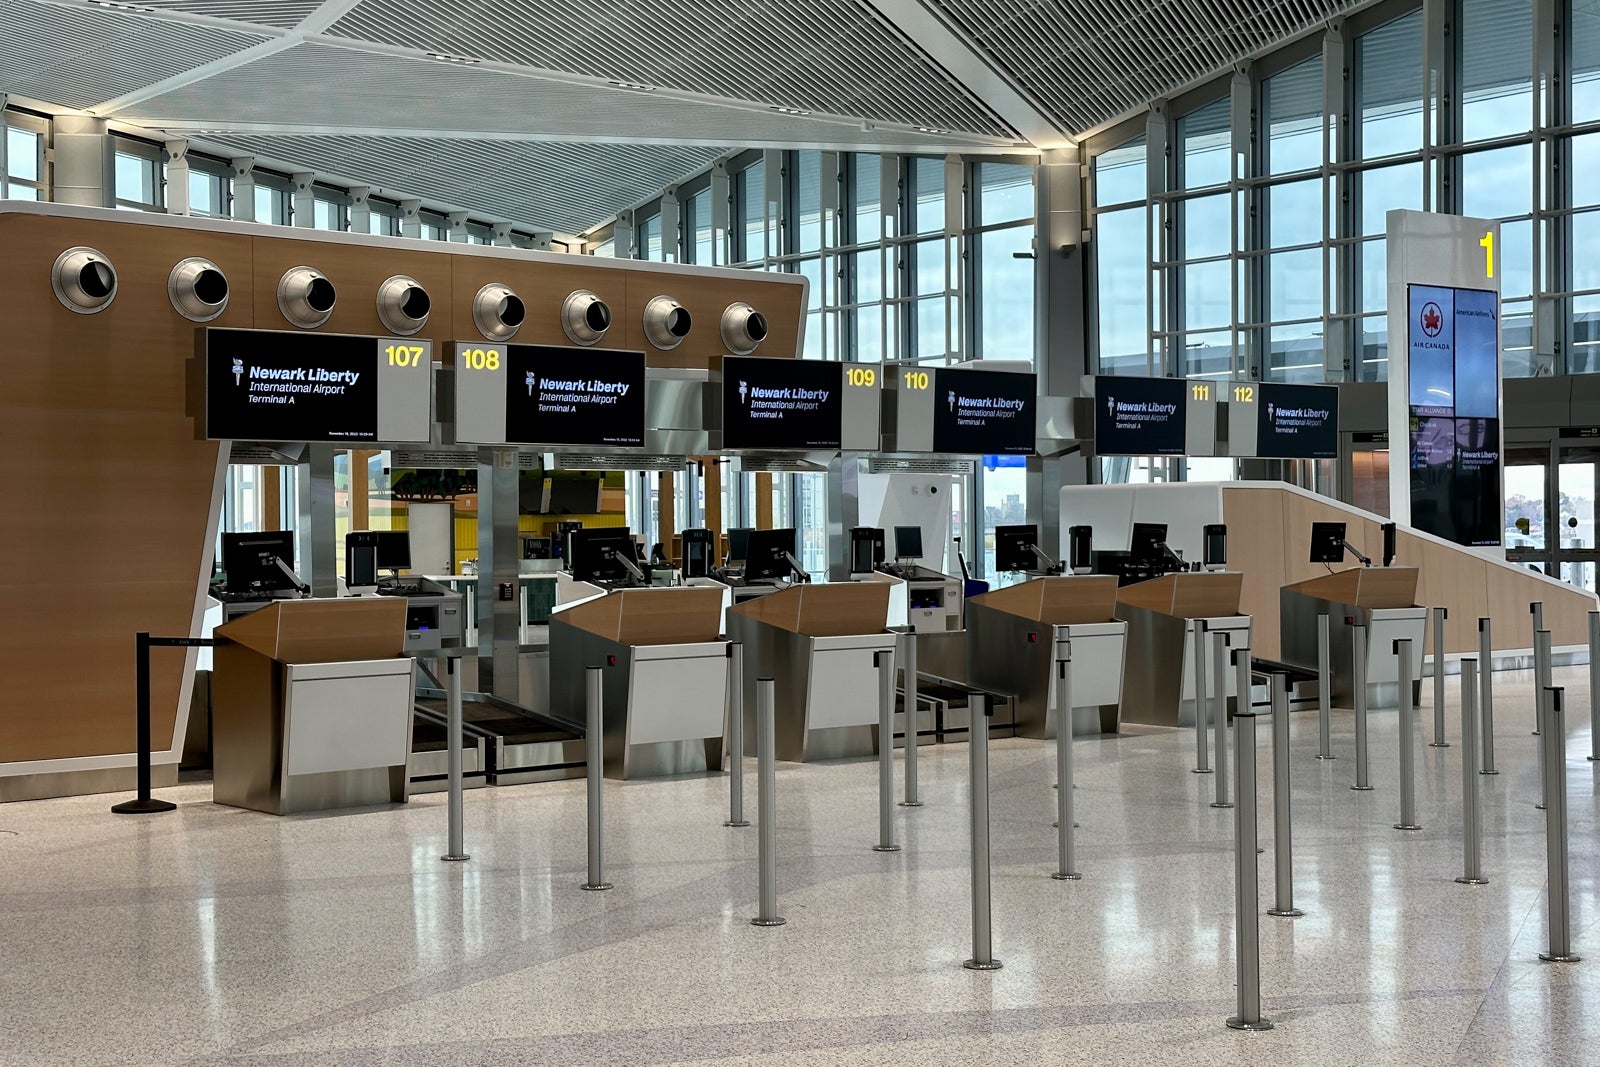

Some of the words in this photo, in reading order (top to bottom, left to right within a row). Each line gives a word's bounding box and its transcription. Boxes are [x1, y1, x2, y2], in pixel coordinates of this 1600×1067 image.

[1480, 232, 1493, 278] 1
[385, 346, 423, 367] 107
[462, 349, 499, 370] 108
[250, 366, 305, 381] Newark
[308, 367, 359, 385] Liberty
[846, 368, 875, 387] 109
[904, 372, 928, 389] 110
[250, 382, 311, 394] International
[314, 384, 345, 396] Airport
[539, 378, 585, 392] Newark
[587, 380, 629, 395] Liberty
[1192, 385, 1209, 401] 111
[248, 395, 286, 404] Terminal
[289, 396, 295, 404] A
[539, 392, 590, 403] International
[591, 394, 617, 405] Airport
[751, 387, 791, 399] Newark
[792, 388, 829, 402] Liberty
[1234, 387, 1253, 403] 112
[538, 404, 569, 413] Terminal
[751, 400, 794, 410] International
[796, 401, 818, 410] Airport
[958, 396, 992, 408] Newark
[993, 398, 1024, 411] Liberty
[1116, 402, 1146, 412] Newark
[1148, 402, 1176, 414] Liberty
[958, 409, 995, 417] International
[996, 410, 1015, 418] Airport
[1276, 408, 1303, 417] Newark
[1304, 408, 1329, 420] Liberty
